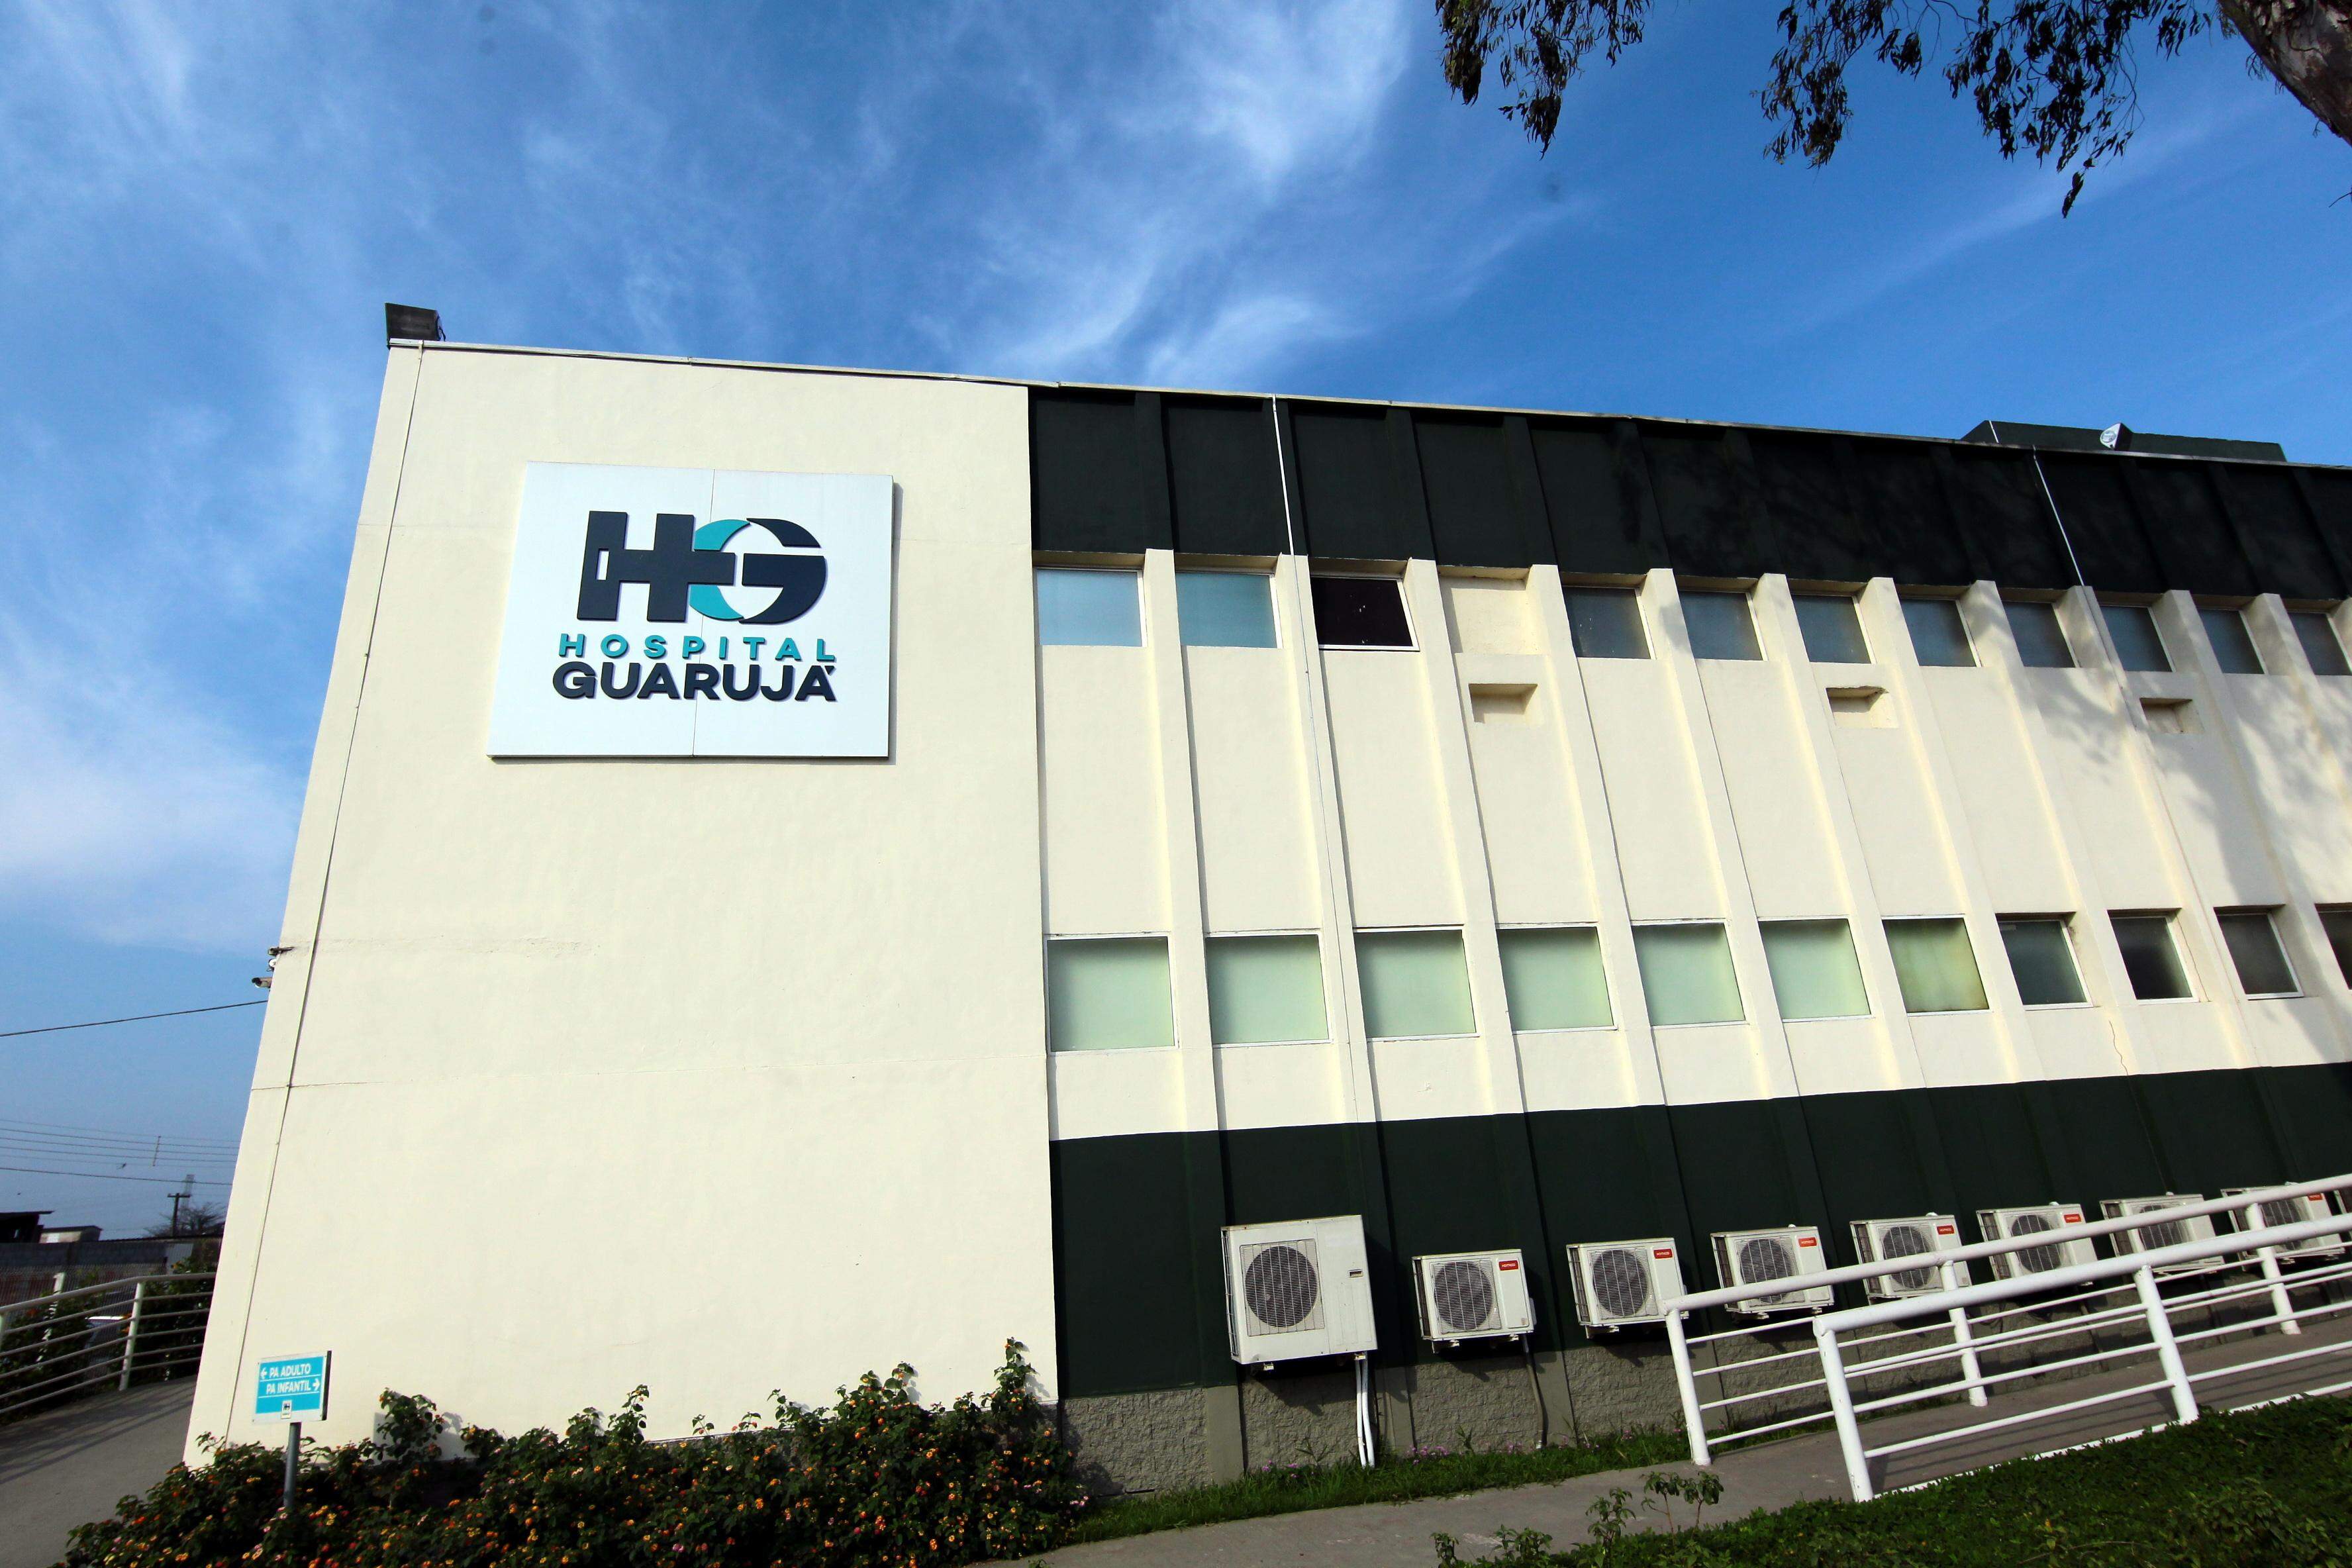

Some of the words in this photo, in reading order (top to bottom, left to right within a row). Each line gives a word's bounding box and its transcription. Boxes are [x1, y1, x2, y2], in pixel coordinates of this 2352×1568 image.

[577, 511, 826, 624] HG
[558, 633, 836, 662] HOSPITAL
[552, 662, 837, 702] GUARUJÁ
[270, 1367, 278, 1377] PA
[281, 1363, 311, 1377] ADULTO
[266, 1383, 275, 1395] PA
[277, 1380, 311, 1393] INFANTIL
